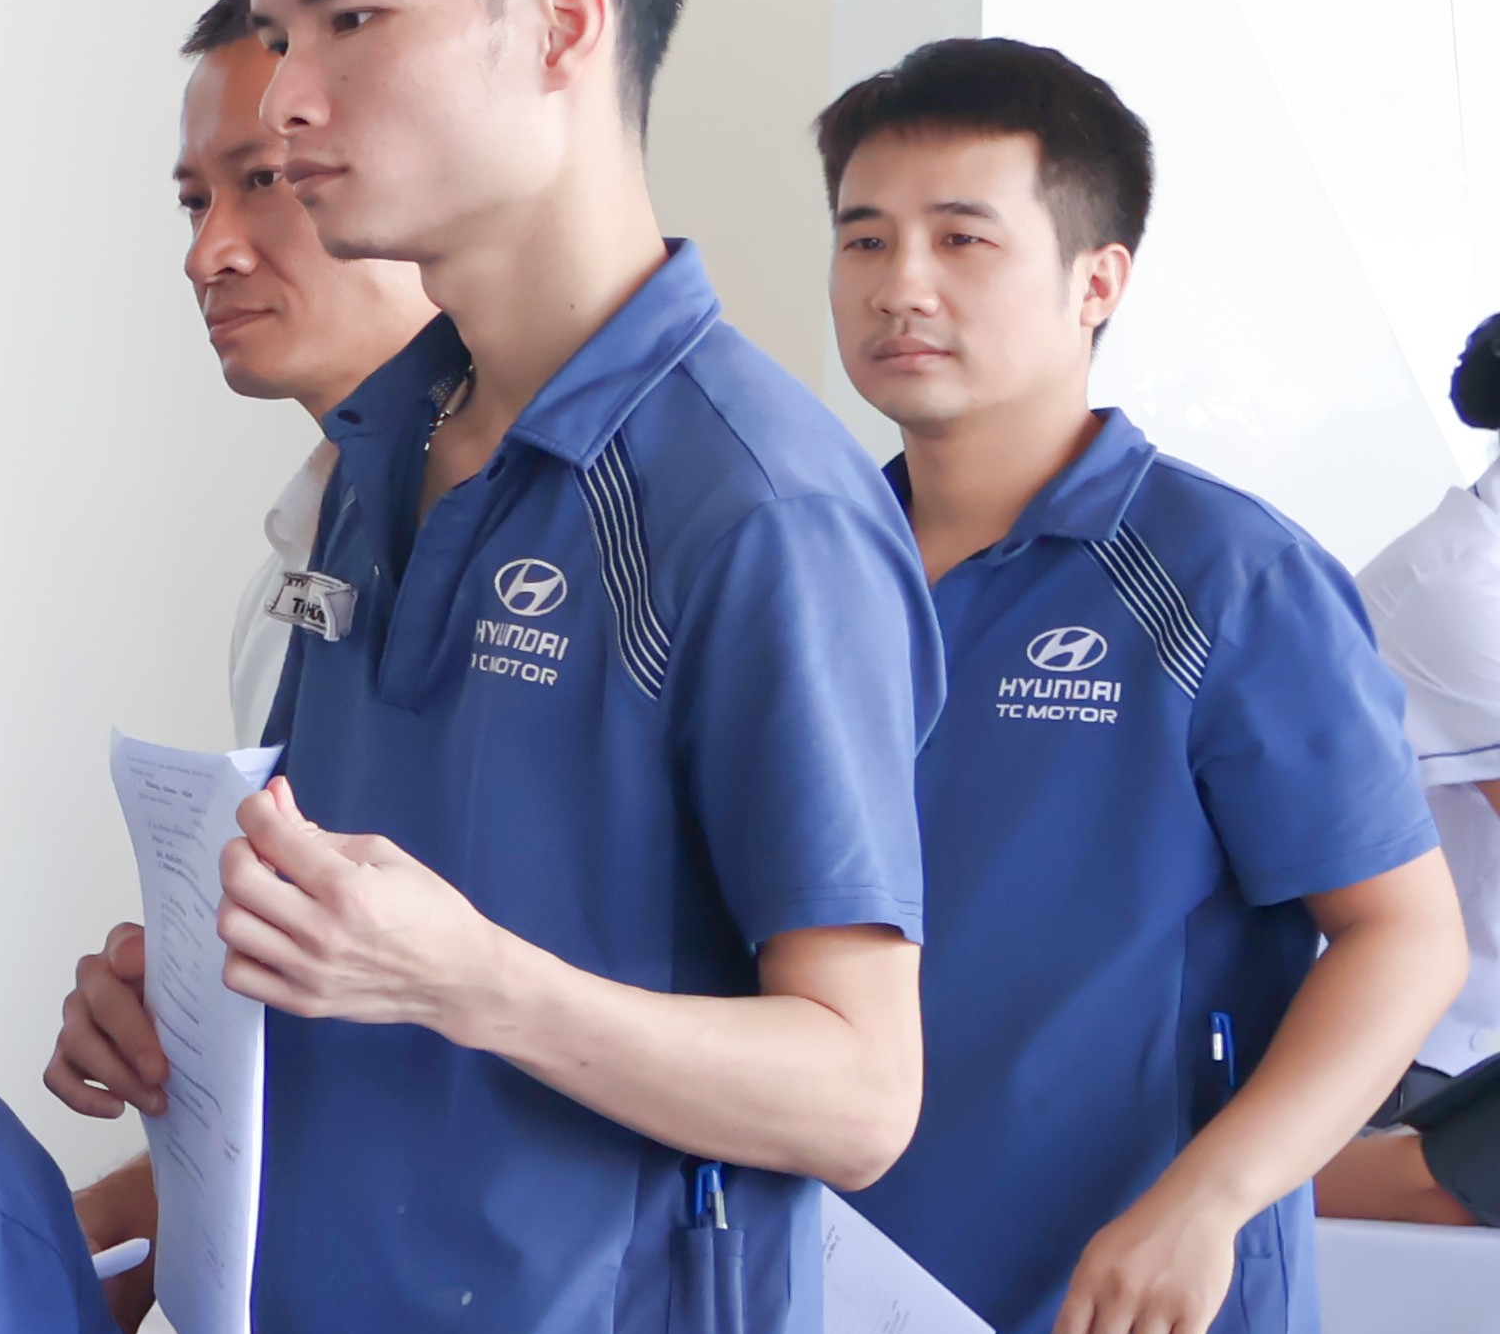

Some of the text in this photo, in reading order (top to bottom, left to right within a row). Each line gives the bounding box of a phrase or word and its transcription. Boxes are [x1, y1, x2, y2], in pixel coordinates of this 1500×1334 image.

[489, 655, 559, 686] OTOR
[998, 677, 1122, 702] HYUNDAI
[996, 703, 1119, 724] TC MOTOR
